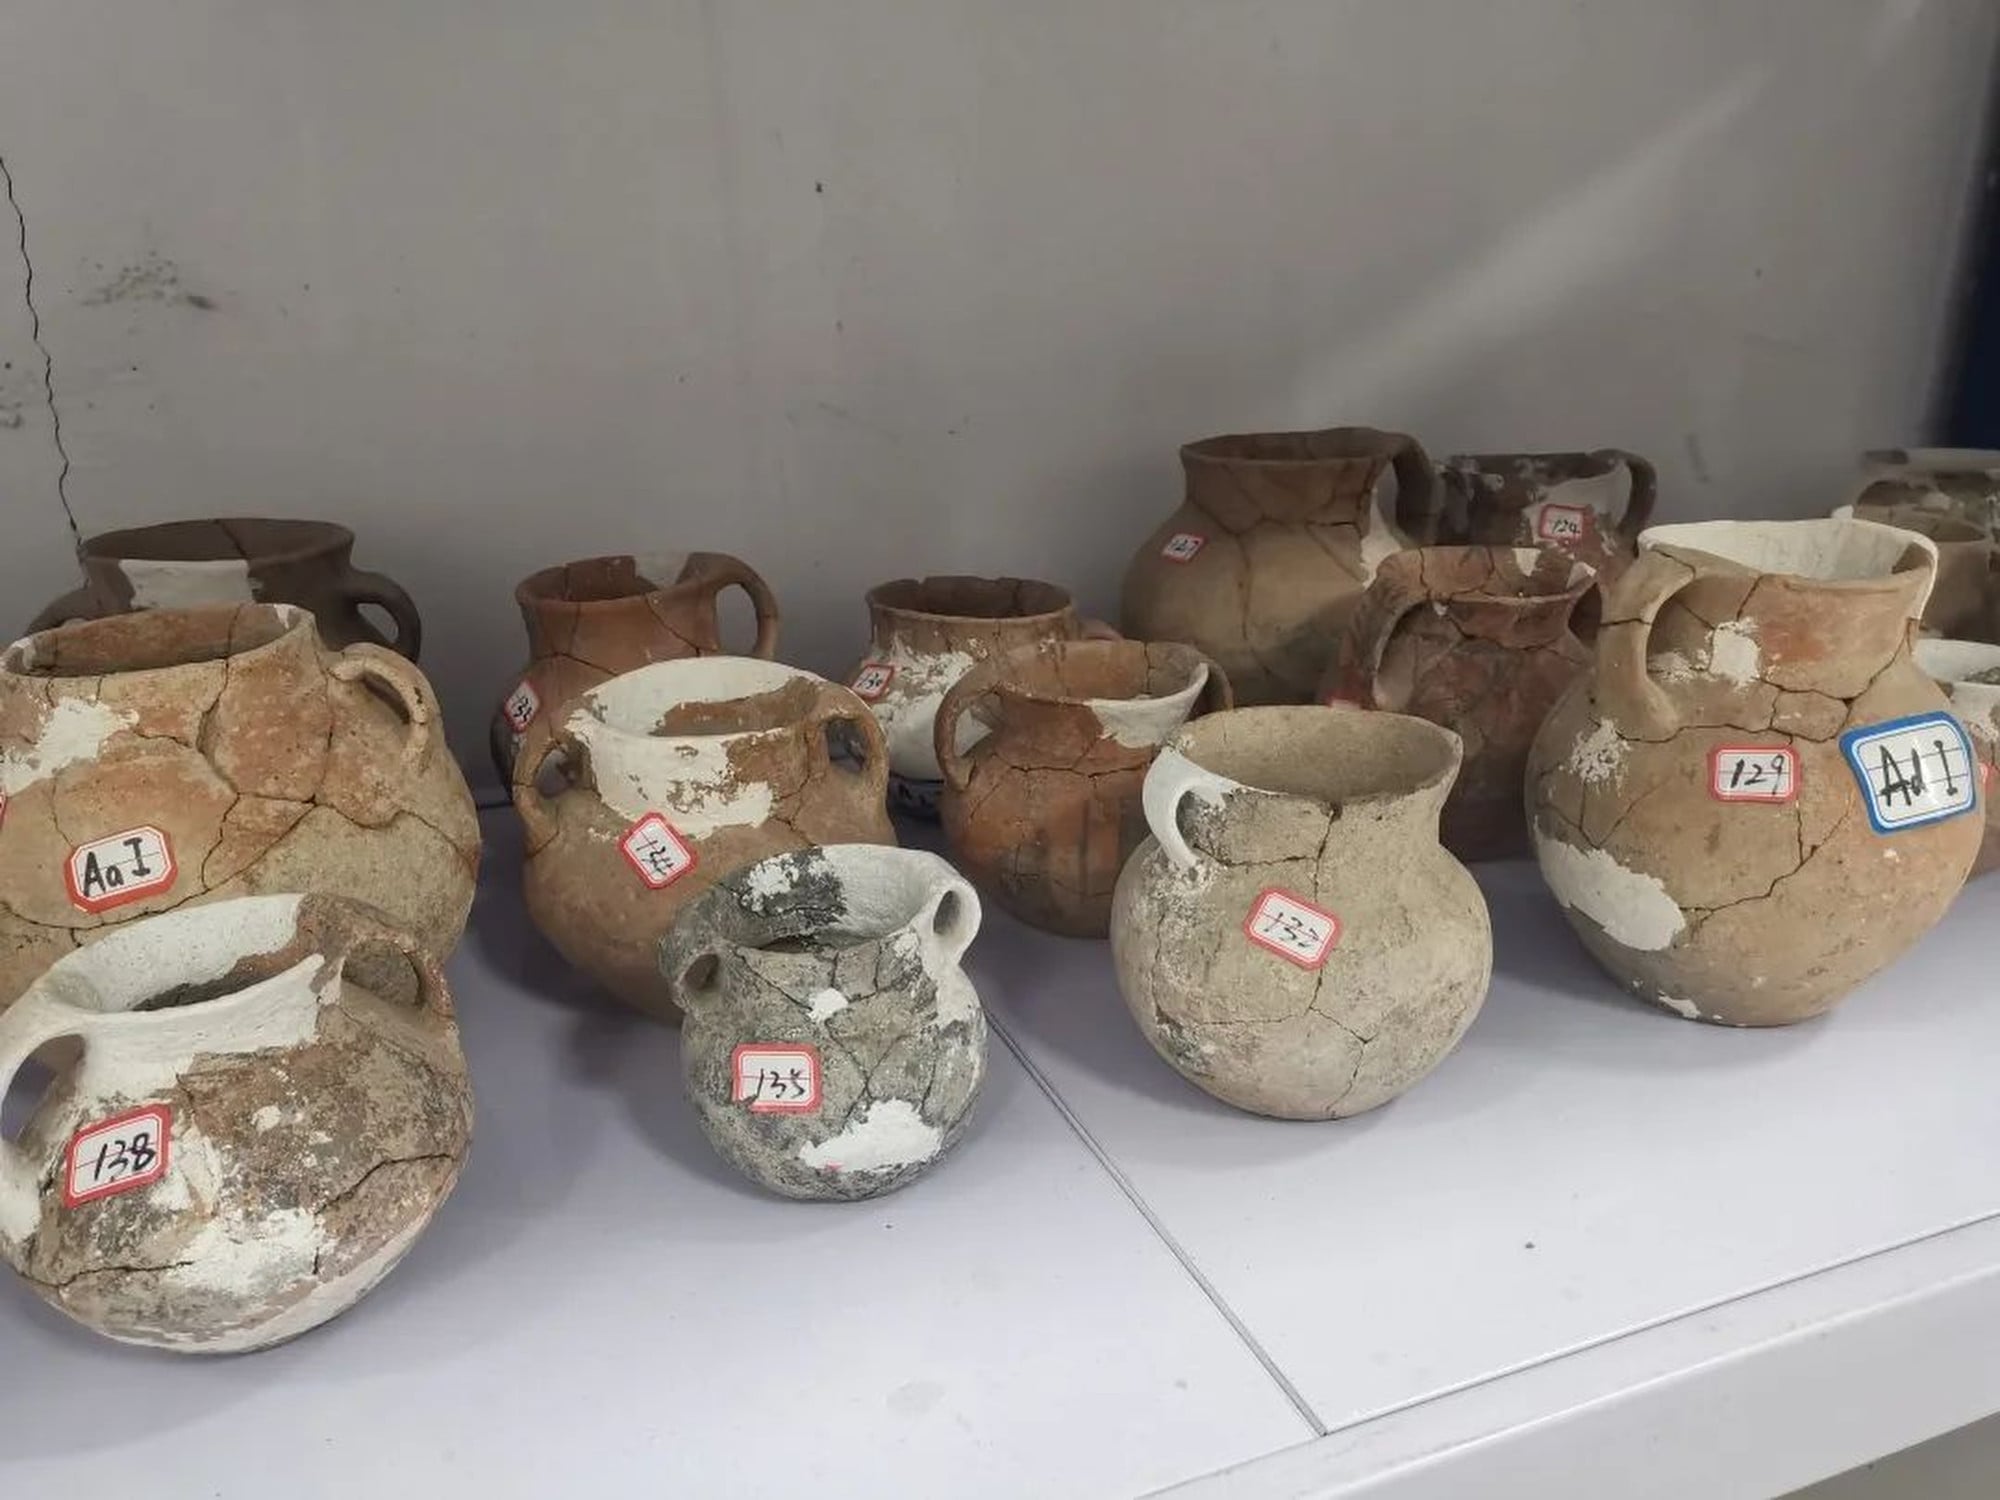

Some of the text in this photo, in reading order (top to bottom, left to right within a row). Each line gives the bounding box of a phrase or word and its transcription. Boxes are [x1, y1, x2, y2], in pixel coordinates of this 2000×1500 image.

[1730, 754, 1785, 795] 129
[755, 1067, 806, 1099] 135
[94, 1132, 156, 1182] 138
